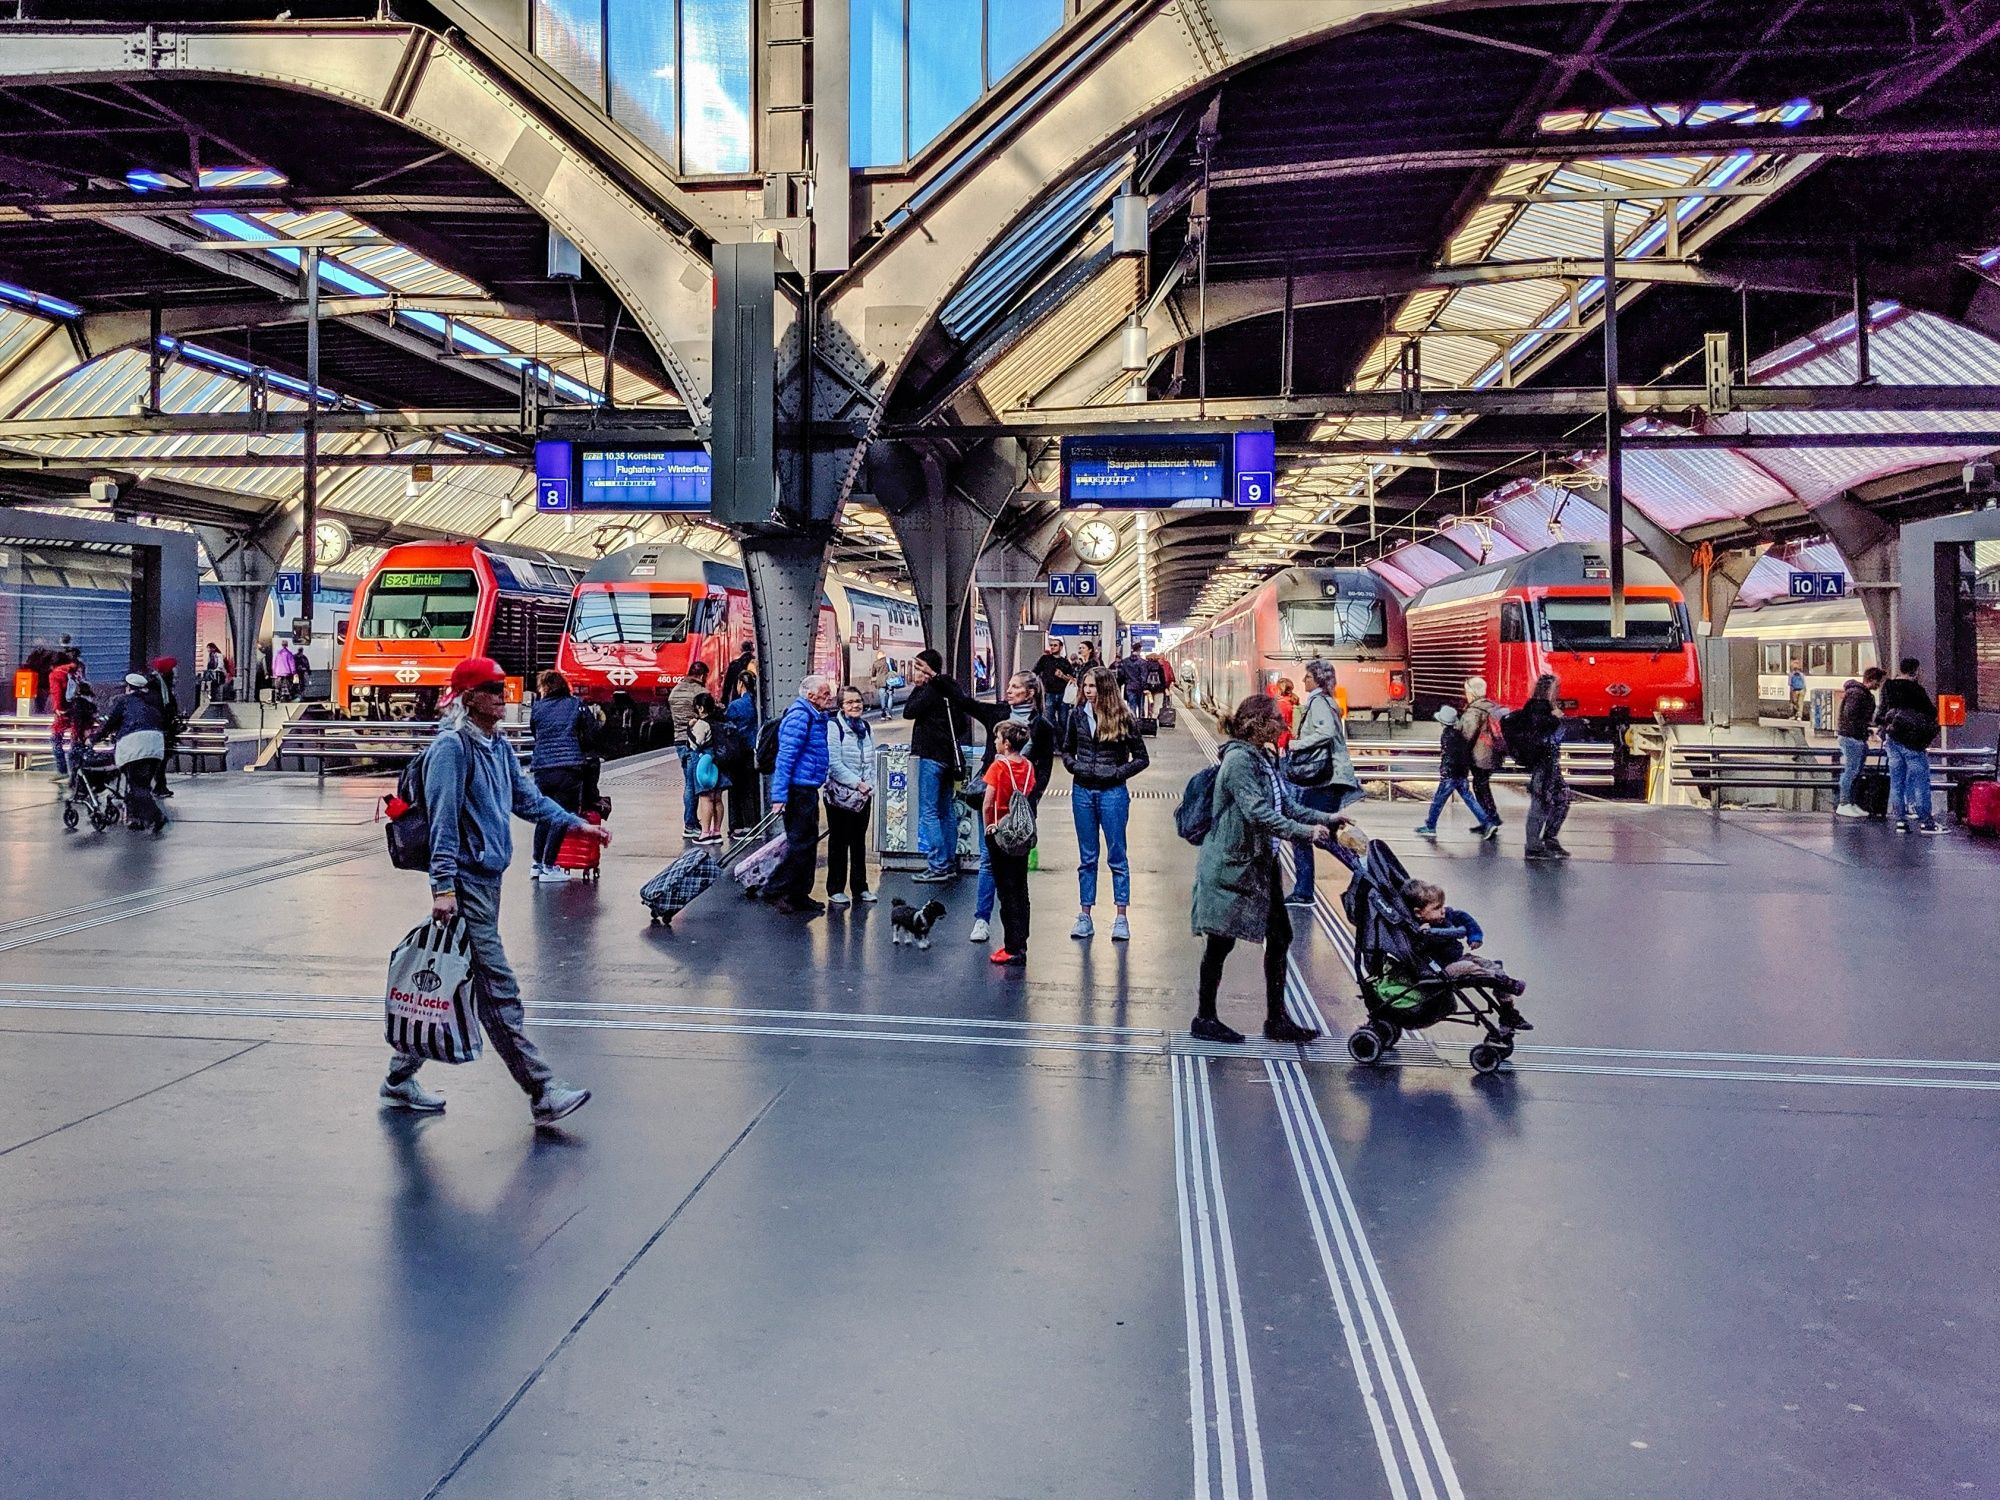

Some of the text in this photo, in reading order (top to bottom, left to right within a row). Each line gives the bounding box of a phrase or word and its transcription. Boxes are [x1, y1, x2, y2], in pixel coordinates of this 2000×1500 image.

[1147, 459, 1190, 468] Innsbruck
[1192, 459, 1216, 468] Wien
[617, 465, 710, 475] Flughafen Winterthur
[547, 490, 558, 505] 8
[1248, 484, 1262, 501] 9
[282, 579, 292, 590] A
[410, 574, 442, 586] Linthal
[1054, 581, 1065, 592] A
[1080, 580, 1090, 593] 9
[1794, 580, 1813, 593] 10
[1826, 580, 1838, 593] A
[657, 675, 671, 683] 460
[390, 986, 450, 1010] Foot Locke
